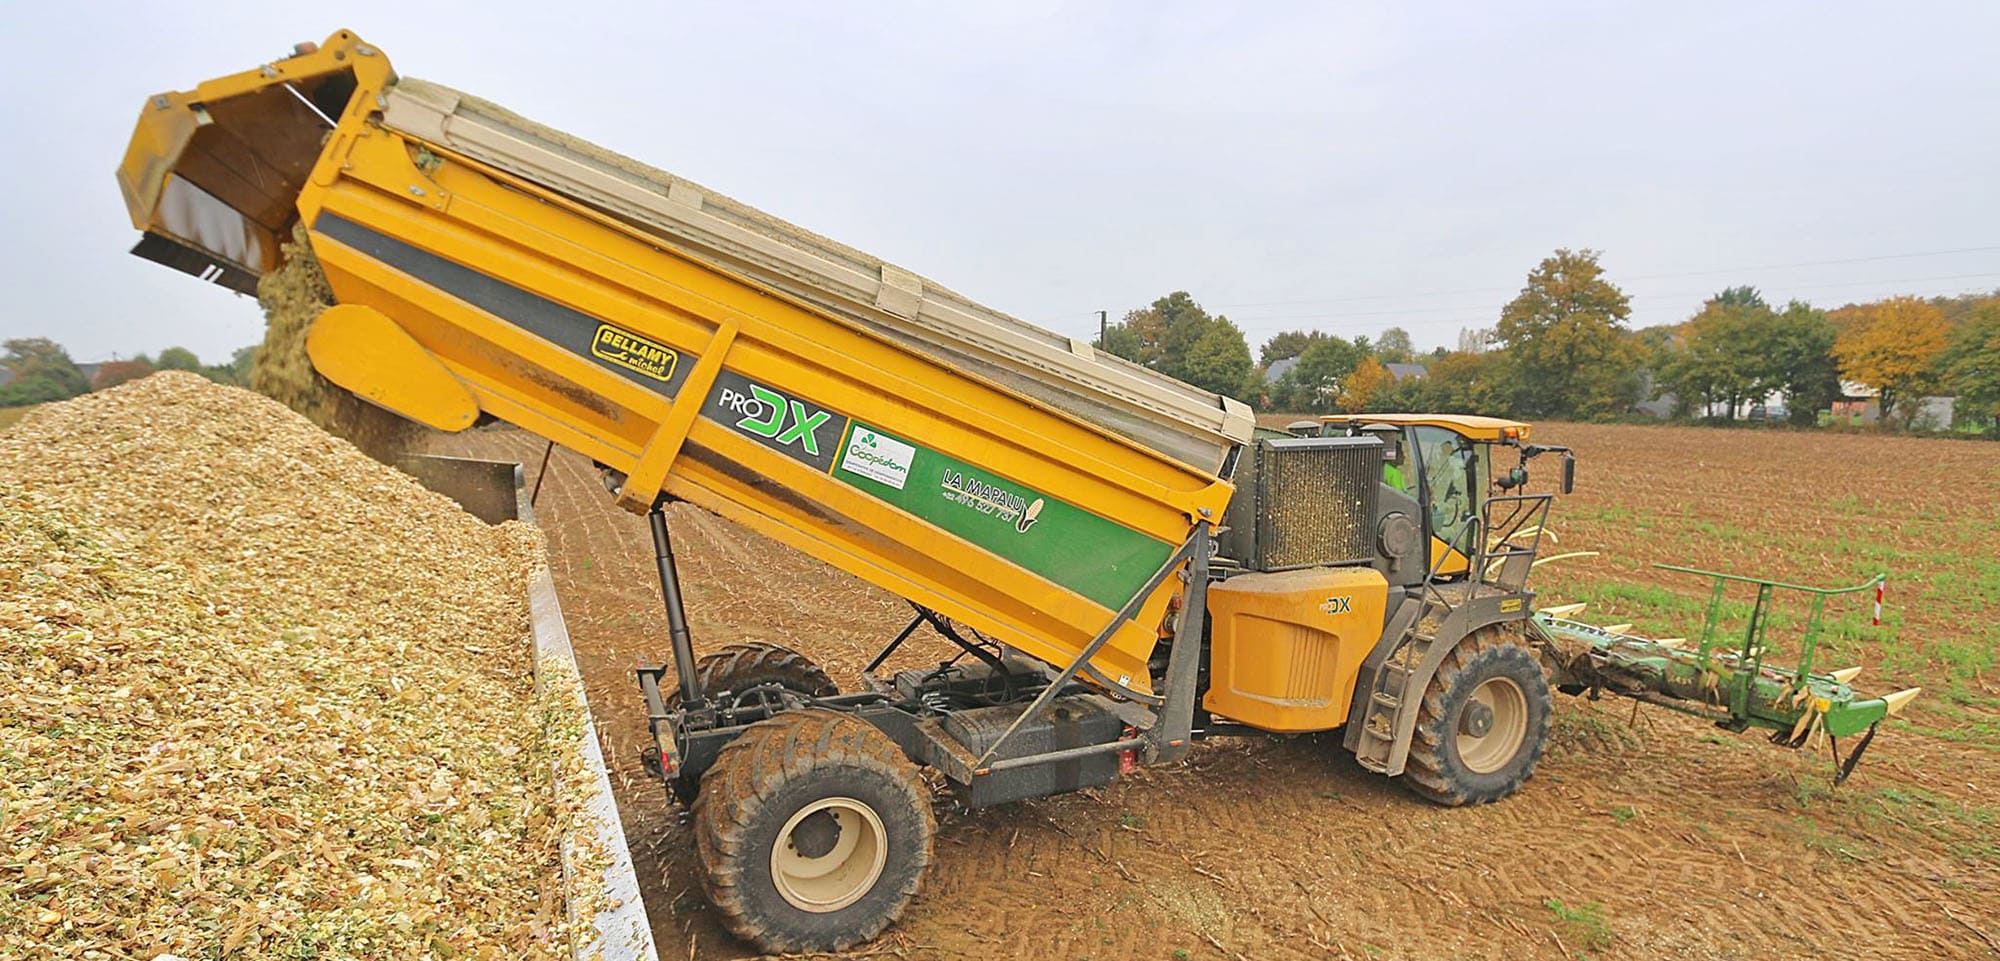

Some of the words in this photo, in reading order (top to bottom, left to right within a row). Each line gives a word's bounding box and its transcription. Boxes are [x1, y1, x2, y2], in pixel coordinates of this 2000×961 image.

[600, 330, 673, 366] BELLAMY
[628, 357, 666, 376] michel
[718, 387, 763, 418] PRO
[736, 383, 832, 456] DX
[942, 468, 962, 490] LA
[965, 477, 1025, 514] MAPALU
